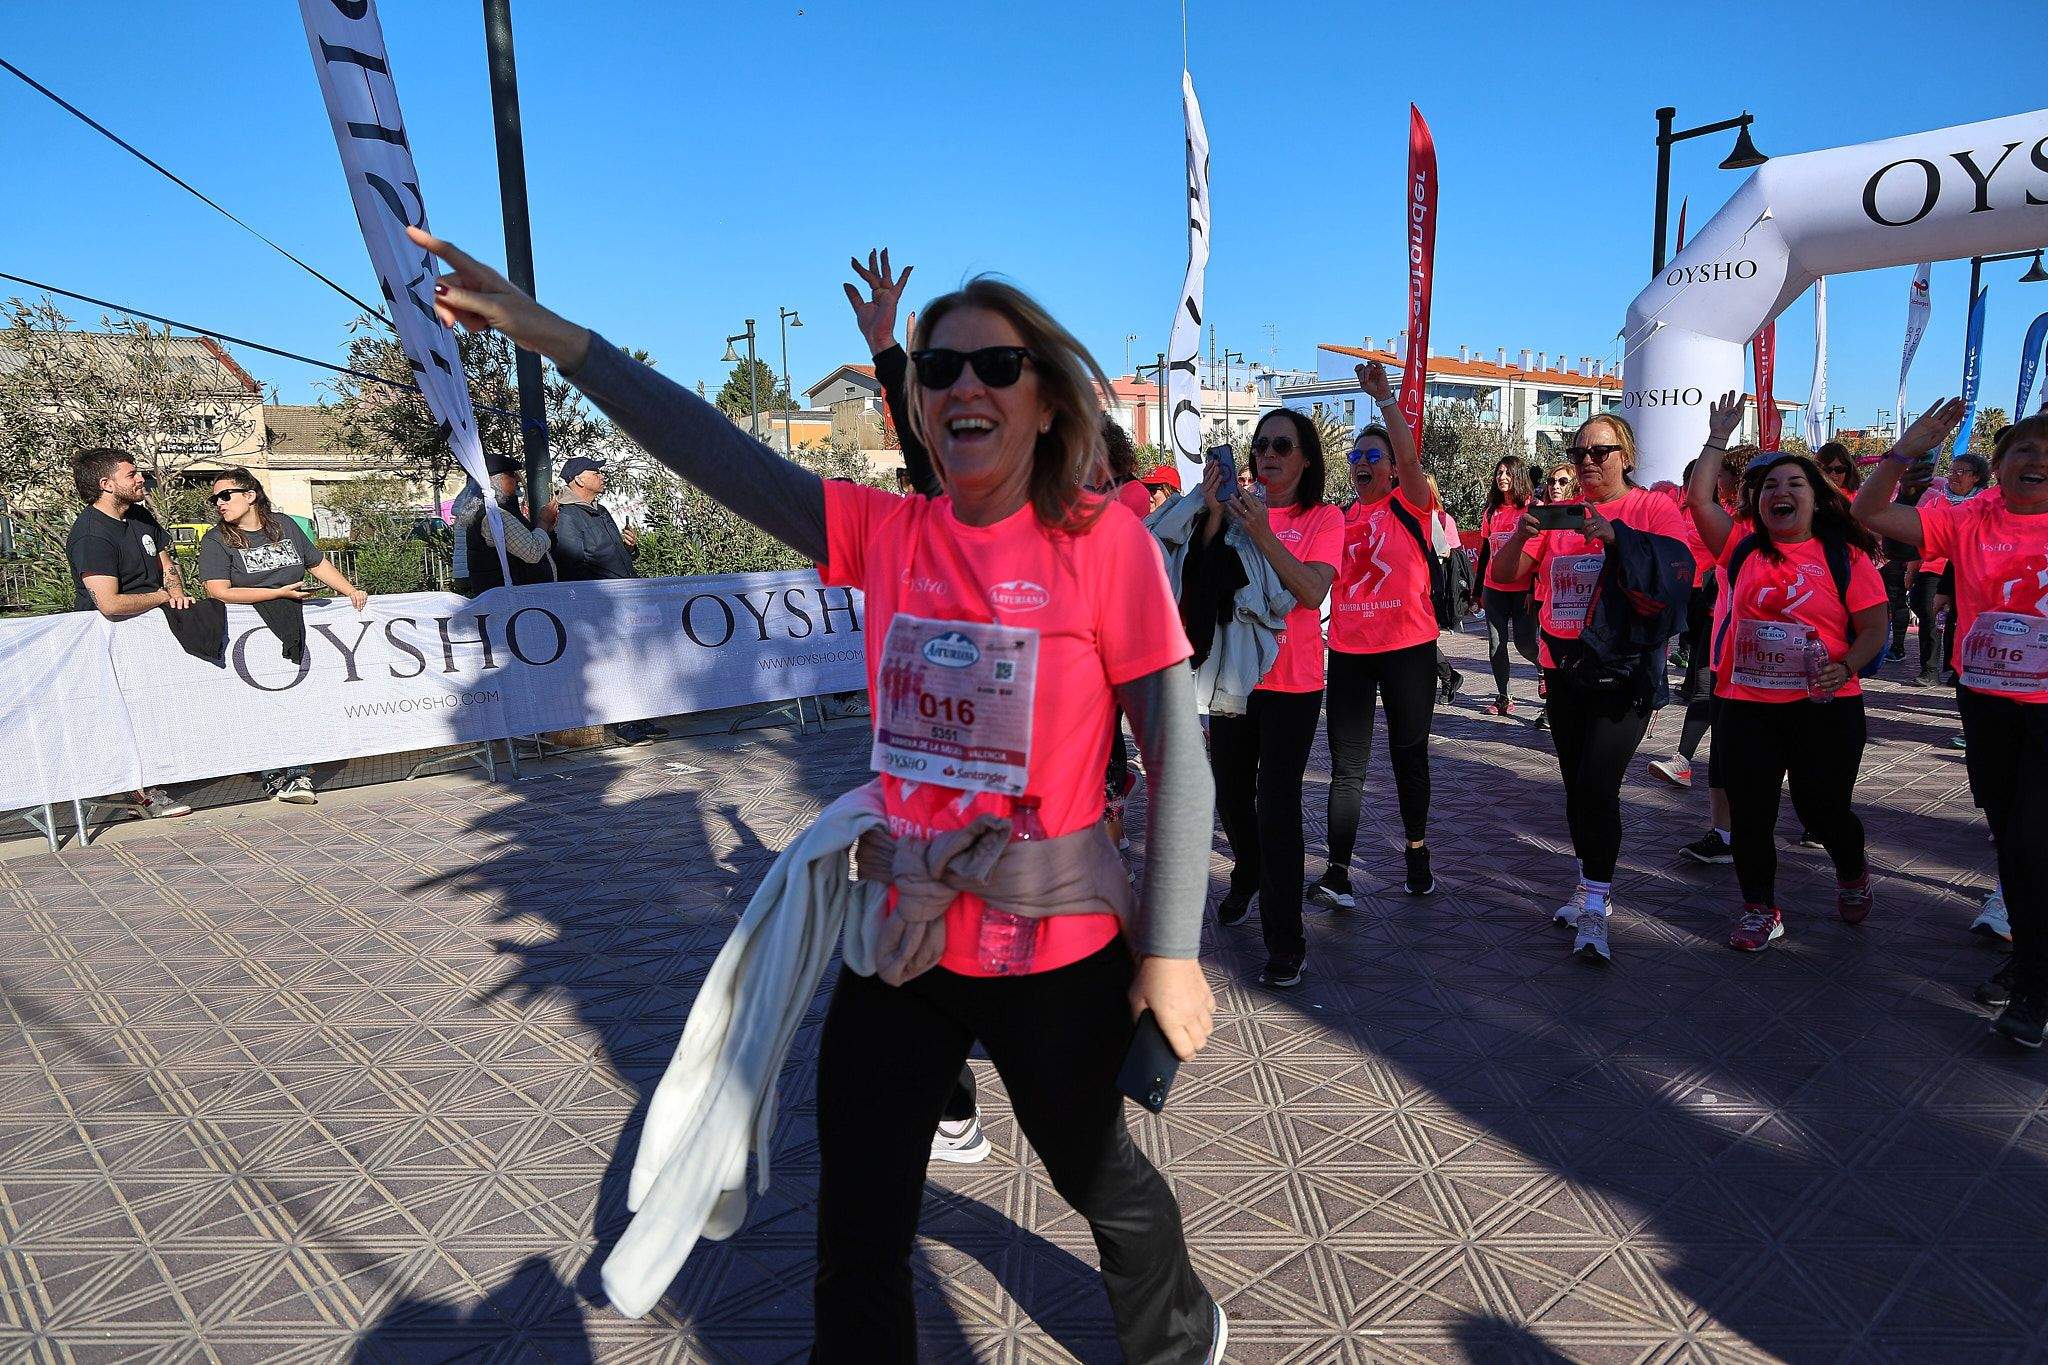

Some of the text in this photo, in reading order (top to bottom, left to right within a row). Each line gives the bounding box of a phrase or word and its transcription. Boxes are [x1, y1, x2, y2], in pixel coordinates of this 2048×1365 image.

[1667, 260, 1757, 286] OYSHO
[1624, 388, 1703, 409] OYSHO
[1576, 584, 1592, 594] 01
[1362, 602, 1370, 611] DE
[1371, 601, 1379, 609] LA
[1380, 600, 1401, 608] MUJER
[682, 587, 863, 647] OYSH
[232, 607, 567, 691] OYSHO
[1756, 651, 1785, 663] 016
[1988, 647, 2023, 661] 016
[759, 649, 864, 671] WWW.OYSHO.COM
[344, 690, 499, 718] WWW.OYSHO.COM
[919, 692, 975, 726] 016
[931, 727, 959, 741] 5351
[955, 768, 1008, 784] Santander
